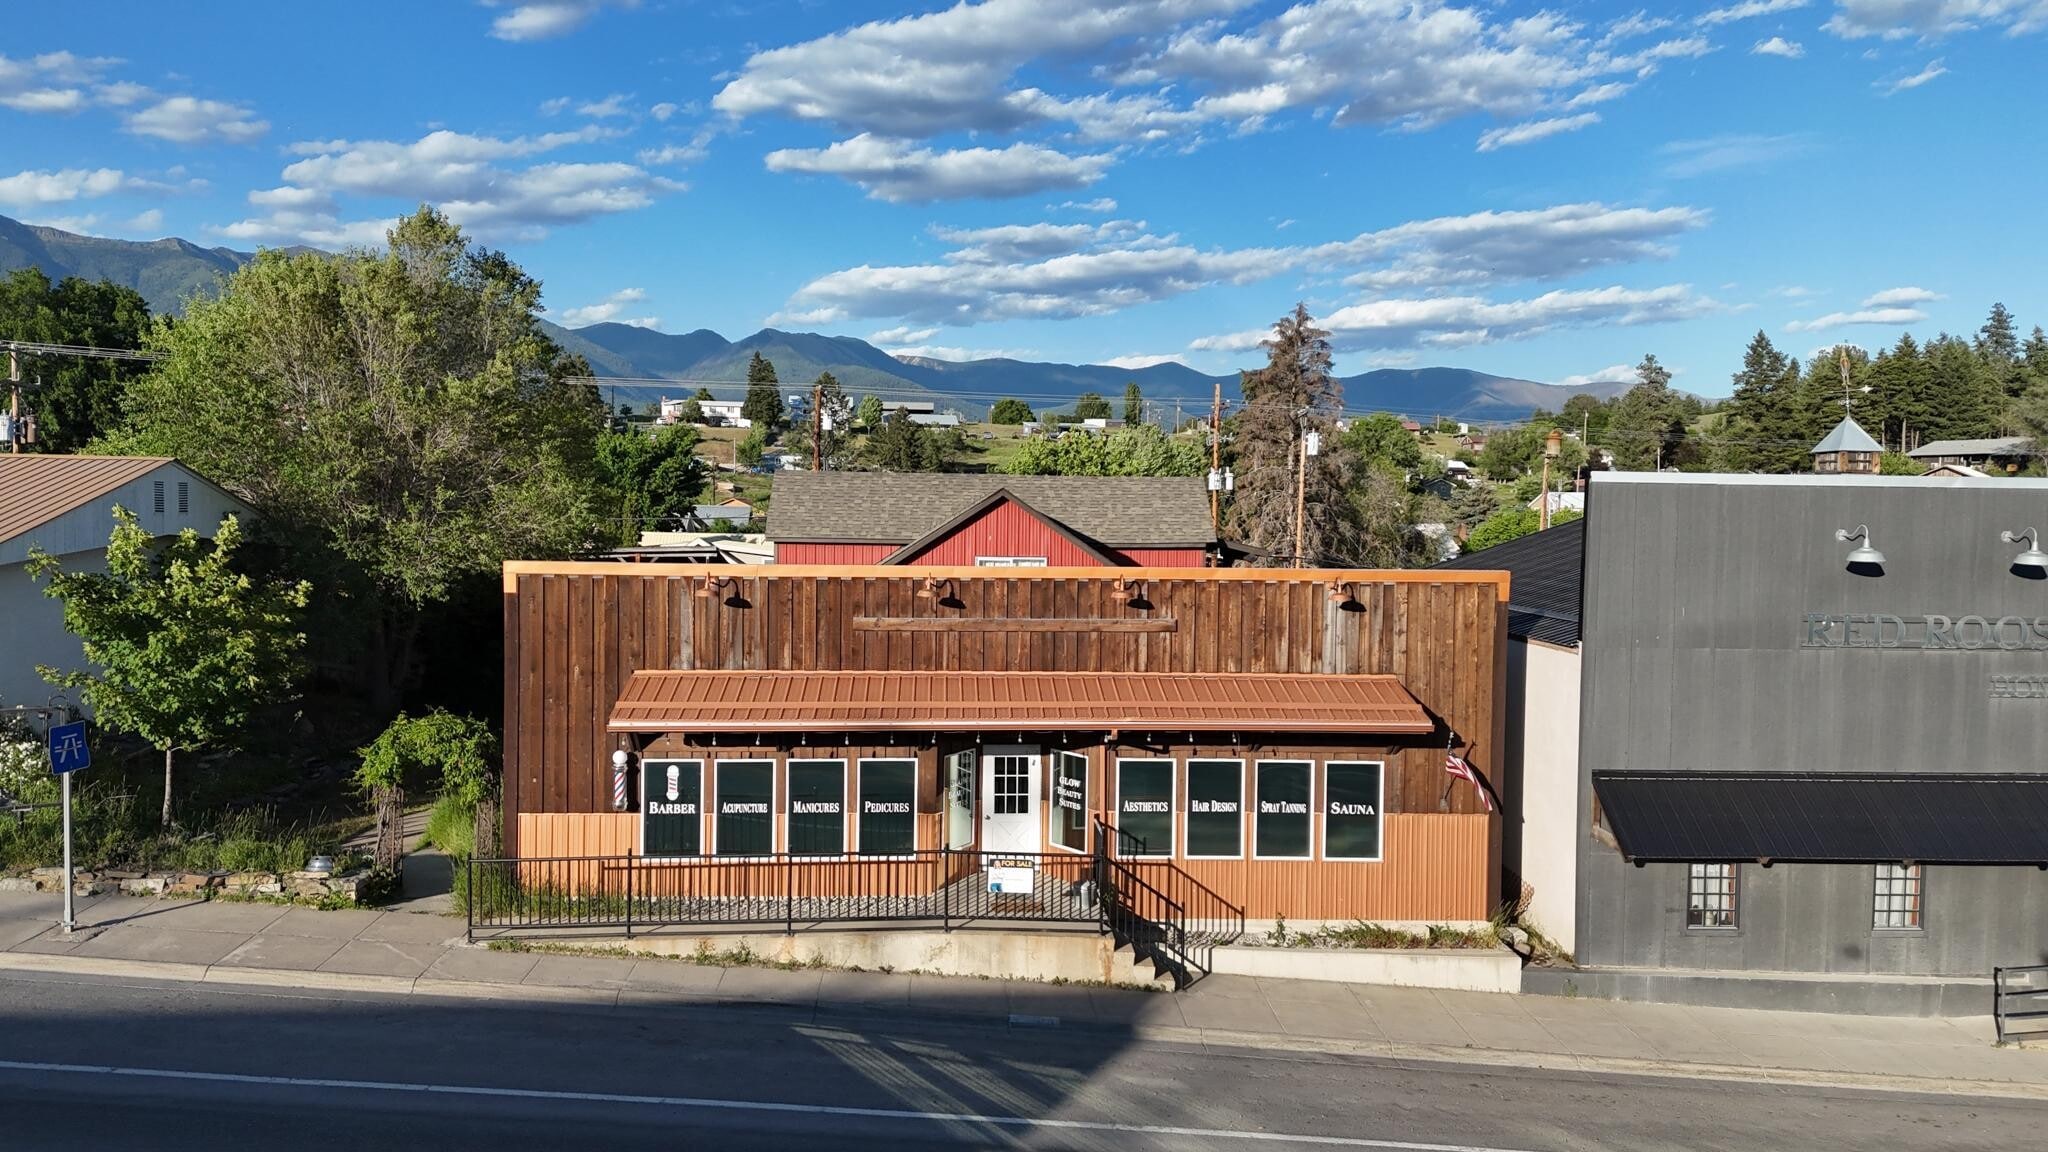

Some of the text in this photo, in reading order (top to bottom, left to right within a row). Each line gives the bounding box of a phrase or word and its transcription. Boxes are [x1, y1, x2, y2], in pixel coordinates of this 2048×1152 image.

[1807, 613, 1906, 647] RED
[1059, 776, 1081, 788] GLOW
[1057, 786, 1082, 800] BEAUTY
[649, 802, 696, 815] BARBER
[721, 802, 768, 814] ACUPUNCTURE
[793, 801, 840, 814] MANICURES
[864, 801, 910, 813] PEDICURES
[1059, 798, 1081, 811] SUITES
[1123, 800, 1168, 813] AESTHETICS
[1192, 800, 1237, 813] HAIR DESIGN
[1261, 801, 1307, 814] SPRAY TANNING
[1331, 802, 1375, 816] SAUNA
[1017, 860, 1033, 868] SALE
